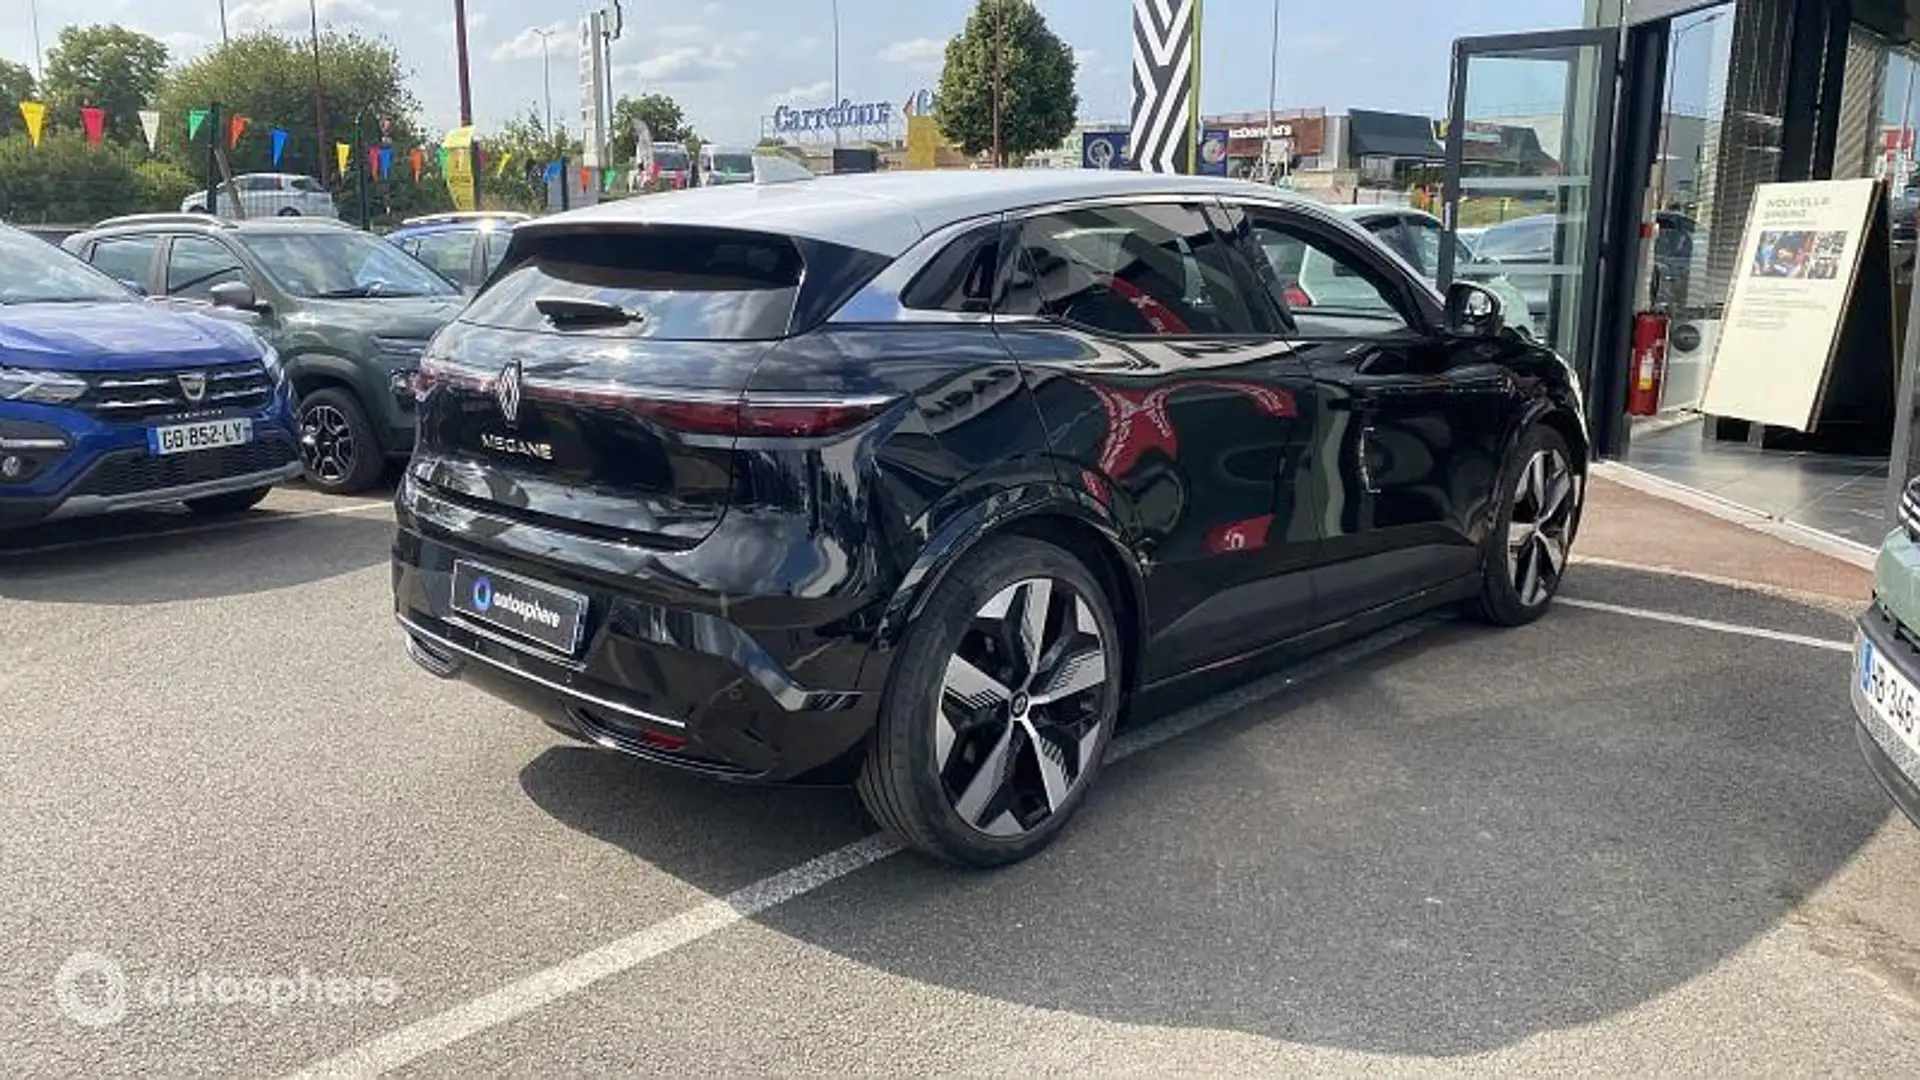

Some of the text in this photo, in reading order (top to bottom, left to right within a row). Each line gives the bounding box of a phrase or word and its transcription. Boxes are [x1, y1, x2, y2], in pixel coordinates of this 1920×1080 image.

[775, 99, 891, 132] Carrefour
[481, 433, 554, 460] MEGANE
[492, 592, 561, 628] autosphere
